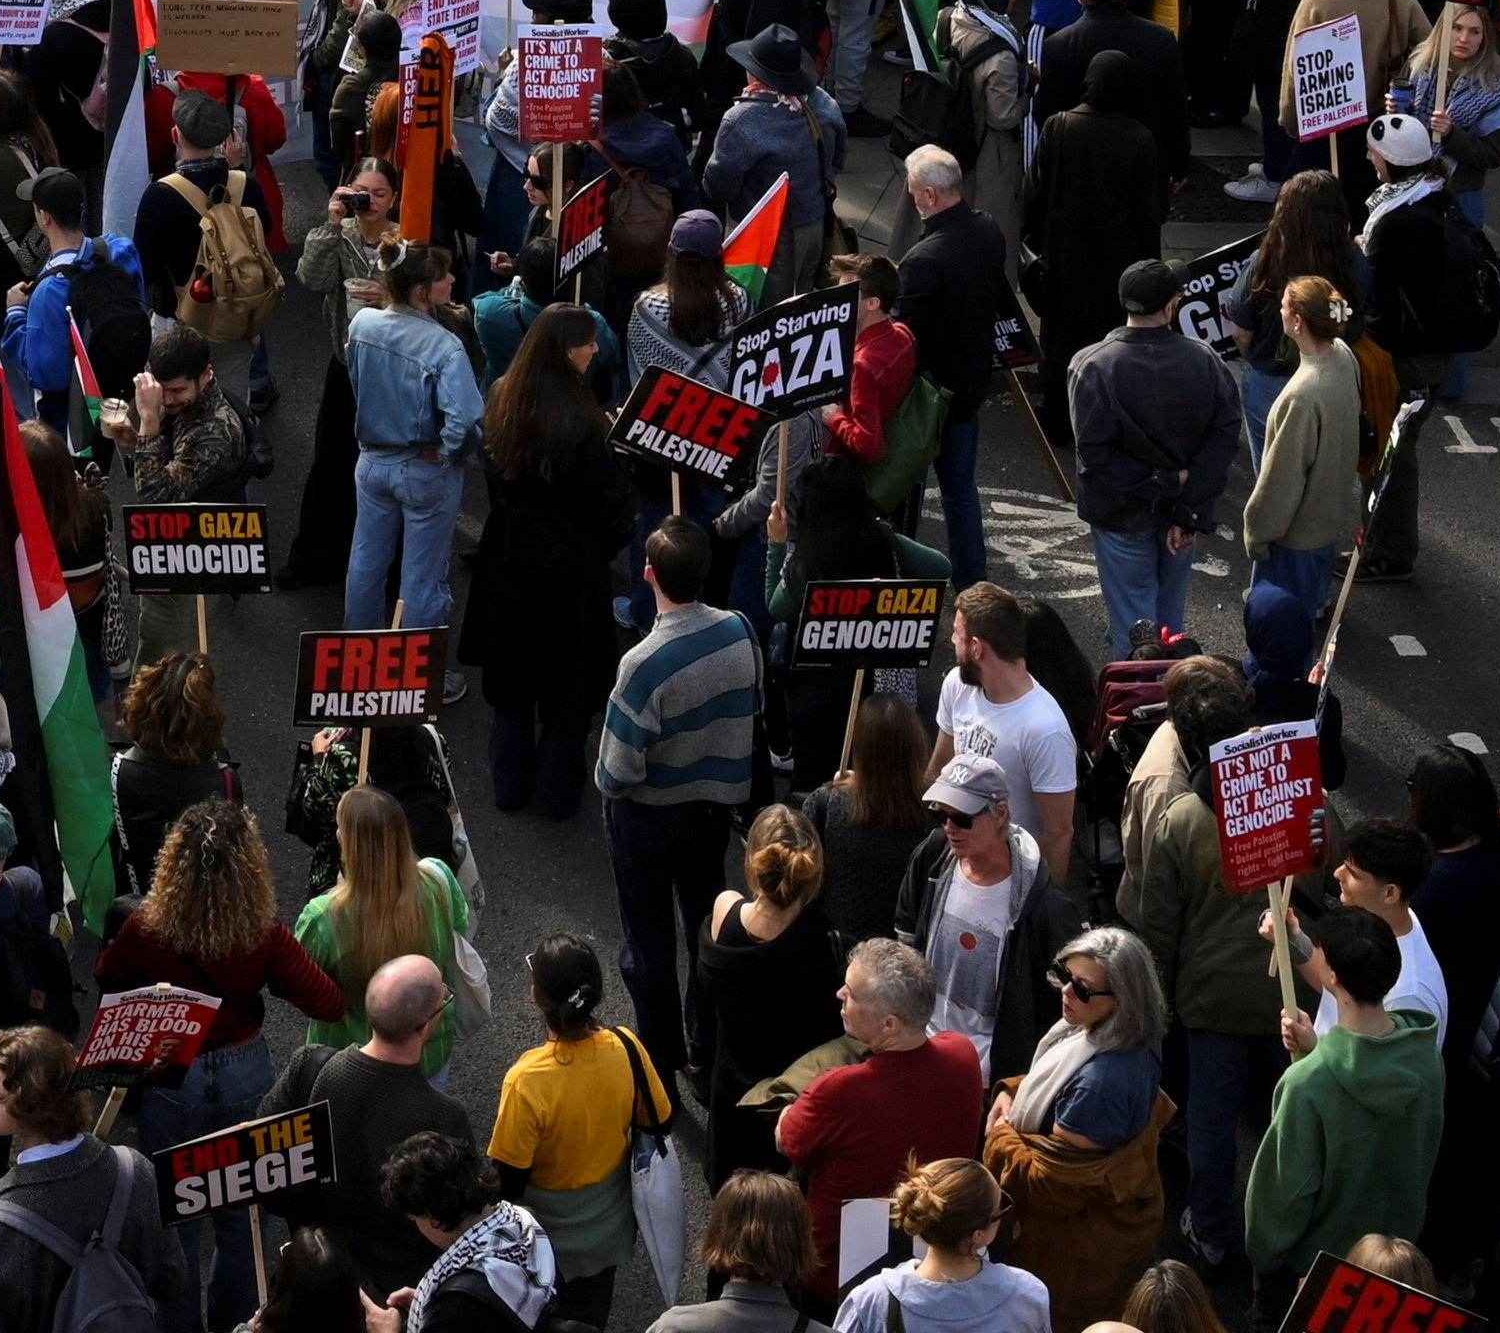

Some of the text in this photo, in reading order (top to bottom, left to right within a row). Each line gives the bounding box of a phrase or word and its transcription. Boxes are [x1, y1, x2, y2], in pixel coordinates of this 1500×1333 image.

[1298, 49, 1334, 75] STOP
[1300, 61, 1355, 97] ARMING
[1301, 89, 1352, 116] ISRAEL
[1302, 101, 1363, 130] FREE PALESTINE
[736, 302, 852, 359] Stop Starving
[732, 328, 844, 408] GAZA
[130, 512, 262, 539] STOP GAZA
[132, 544, 266, 574] GENOCIDE
[313, 635, 430, 692] FREE
[310, 690, 426, 716] PALESTINE
[1218, 743, 1292, 780] IT'S NOT A
[1220, 763, 1288, 799] CRIME TO
[1223, 777, 1314, 819] ACT AGAINST
[1225, 801, 1295, 838] GENOCIDE
[171, 1112, 313, 1181] END THE
[174, 1142, 317, 1215] SIEGE
